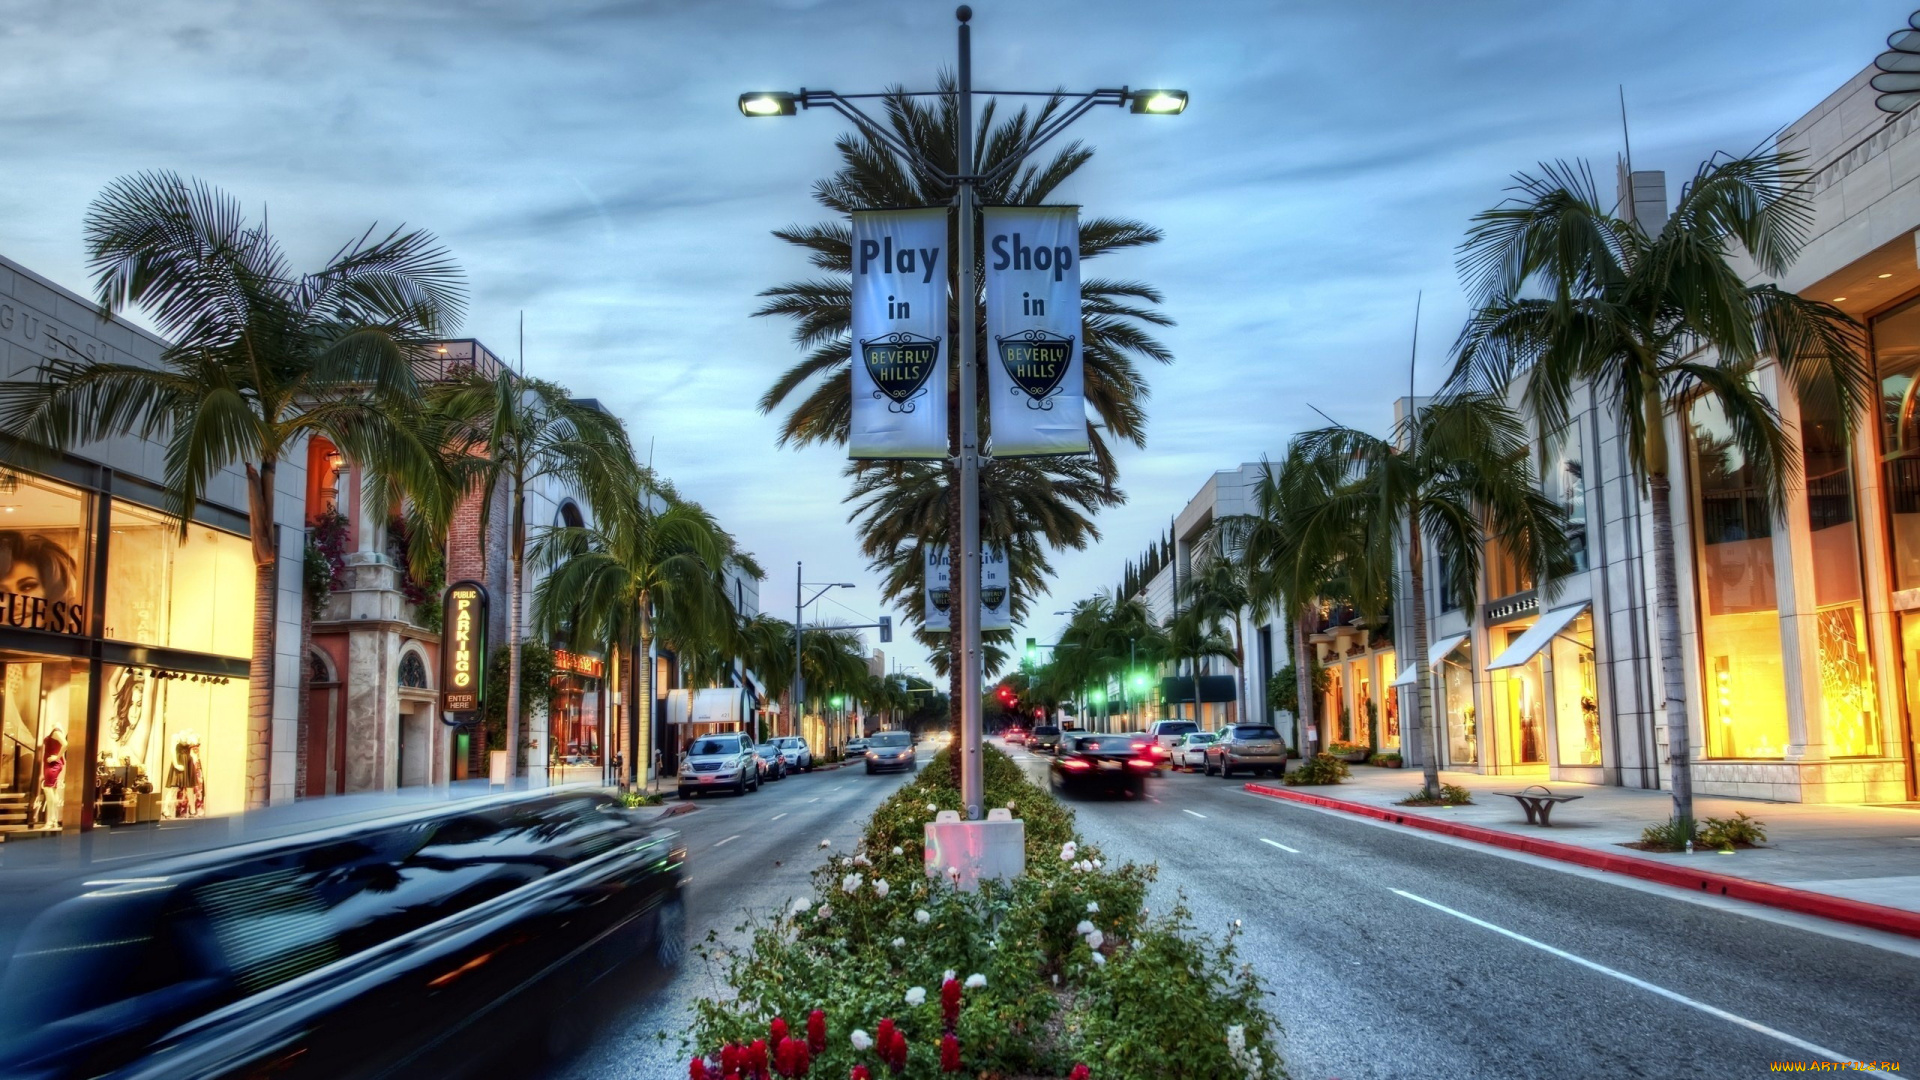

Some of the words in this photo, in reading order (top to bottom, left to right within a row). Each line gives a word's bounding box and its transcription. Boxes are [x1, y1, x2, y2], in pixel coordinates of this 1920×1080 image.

[860, 236, 940, 284] Play
[991, 233, 1073, 282] Shop
[887, 295, 910, 320] in
[1022, 291, 1045, 316] in
[871, 350, 930, 365] BEVERLY
[1007, 348, 1064, 362] BEVERLY
[880, 366, 920, 381] HILLS
[1017, 364, 1056, 378] HILLS
[929, 553, 949, 566] Din
[938, 572, 947, 581] in
[987, 571, 996, 580] in
[453, 590, 477, 599] PUBLIC
[455, 599, 471, 672] PARKING
[448, 694, 472, 702] ENTER
